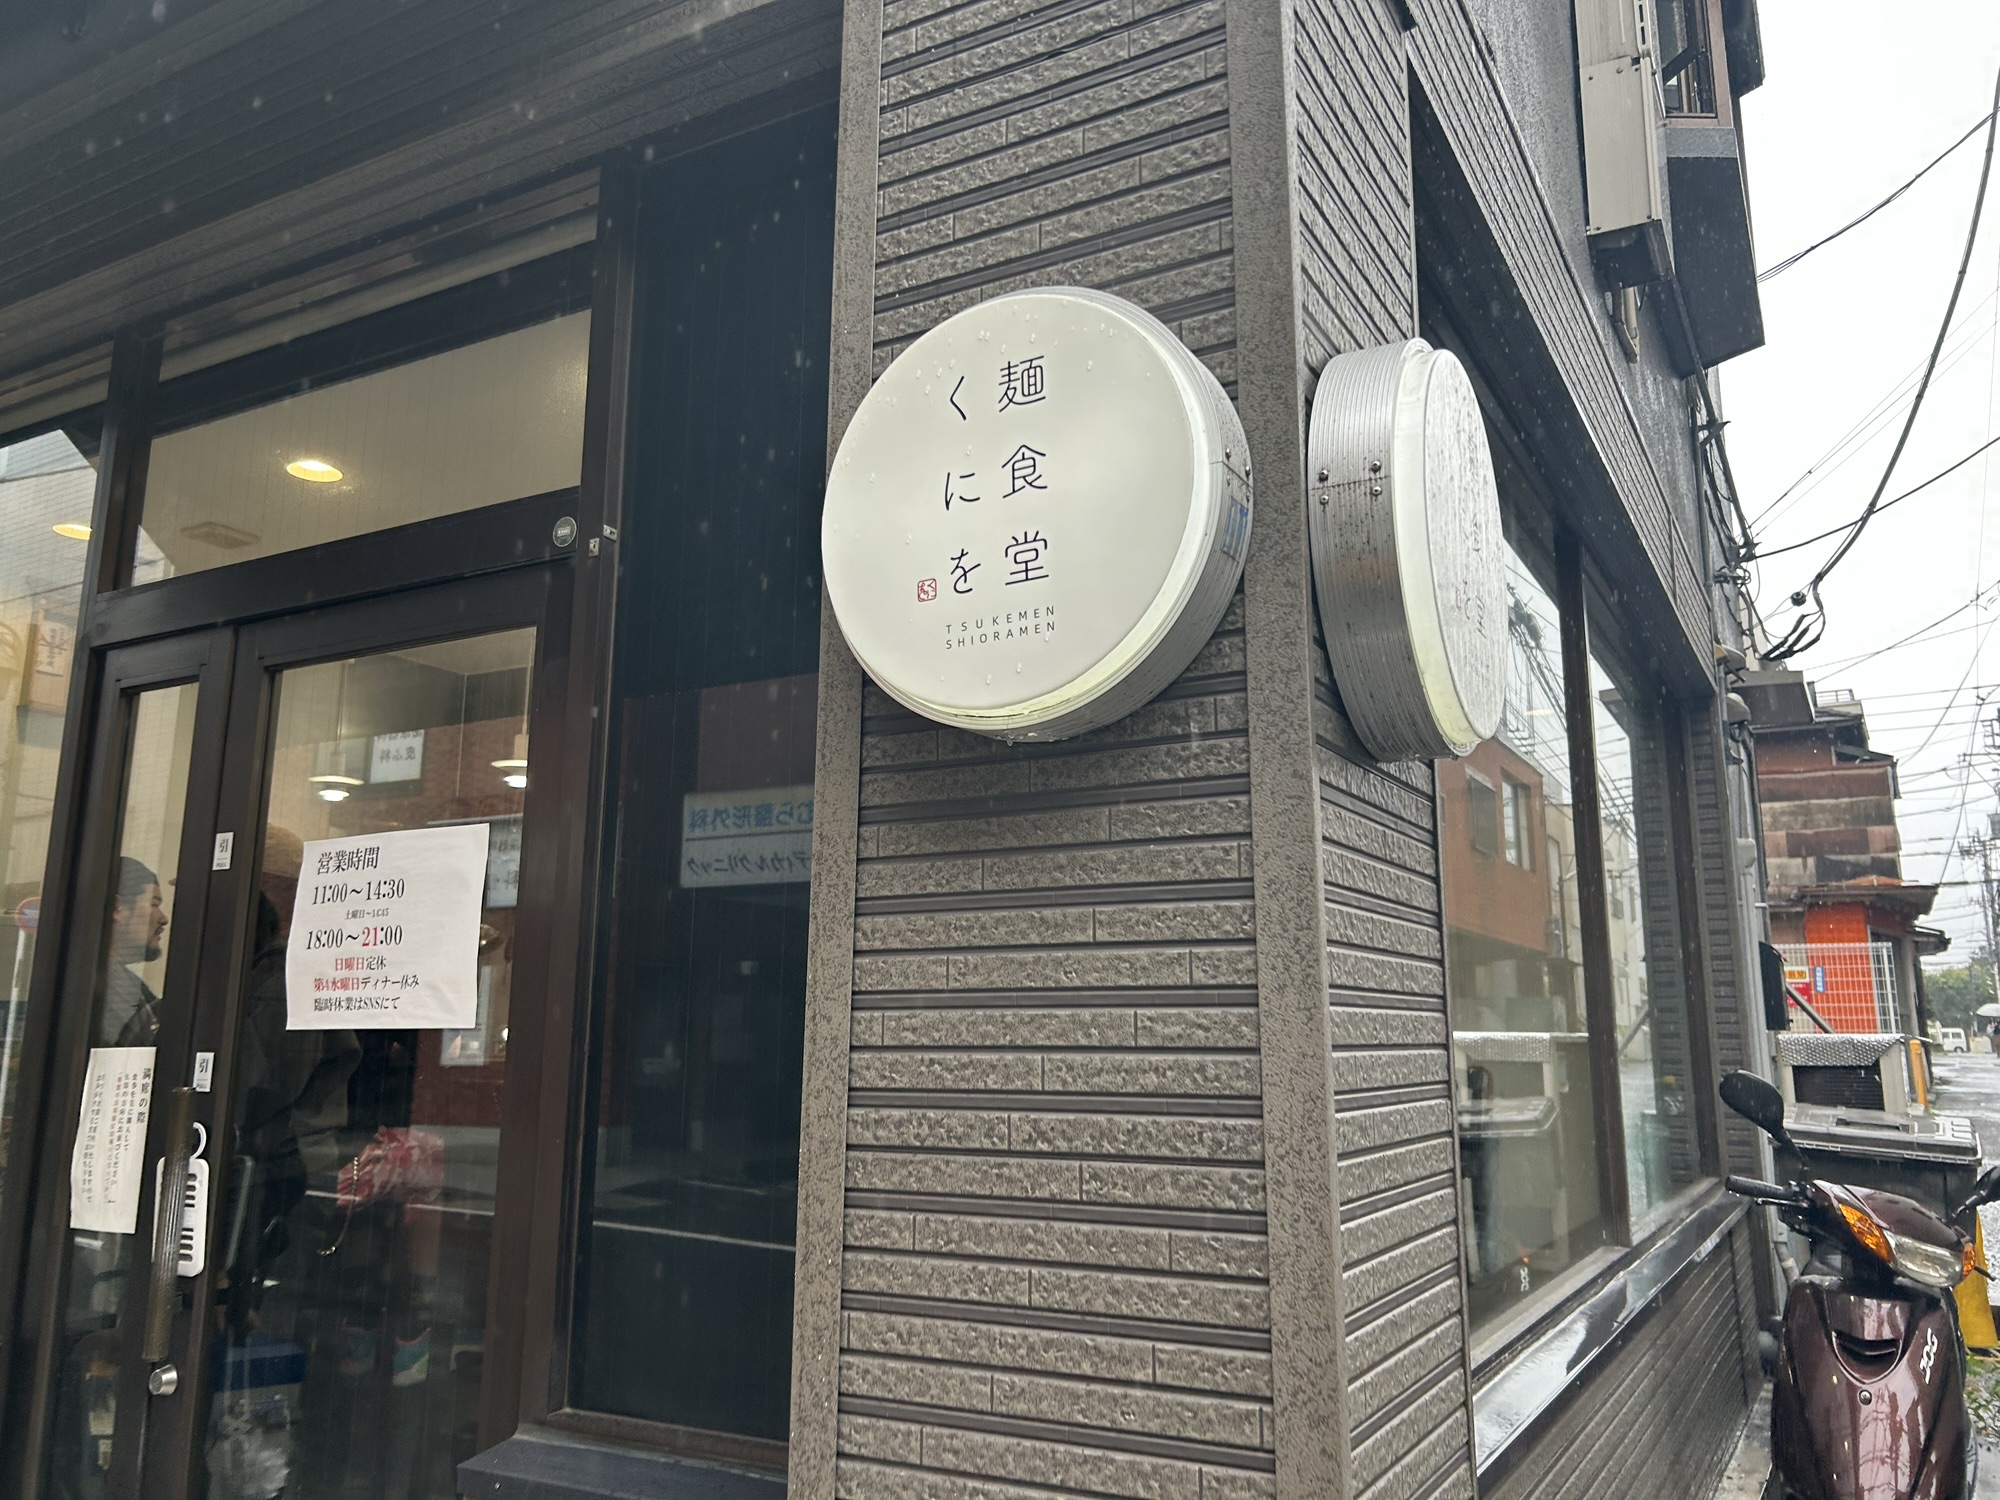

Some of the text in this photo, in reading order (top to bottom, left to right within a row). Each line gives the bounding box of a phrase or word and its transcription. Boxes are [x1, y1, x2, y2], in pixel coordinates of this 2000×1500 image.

[998, 355, 1050, 587] 麺食堂
[945, 375, 981, 594] くにを
[945, 605, 1055, 635] TSUKEMEN
[945, 621, 1055, 650] SHIORAMEN
[220, 838, 229, 853] 引
[317, 846, 380, 875] 営業時間
[335, 955, 387, 972] 日曜日定休
[314, 974, 420, 992] 第4水曜日ディナー休み
[314, 996, 401, 1012] 臨時休業はSNSにて
[200, 1058, 209, 1073] 引
